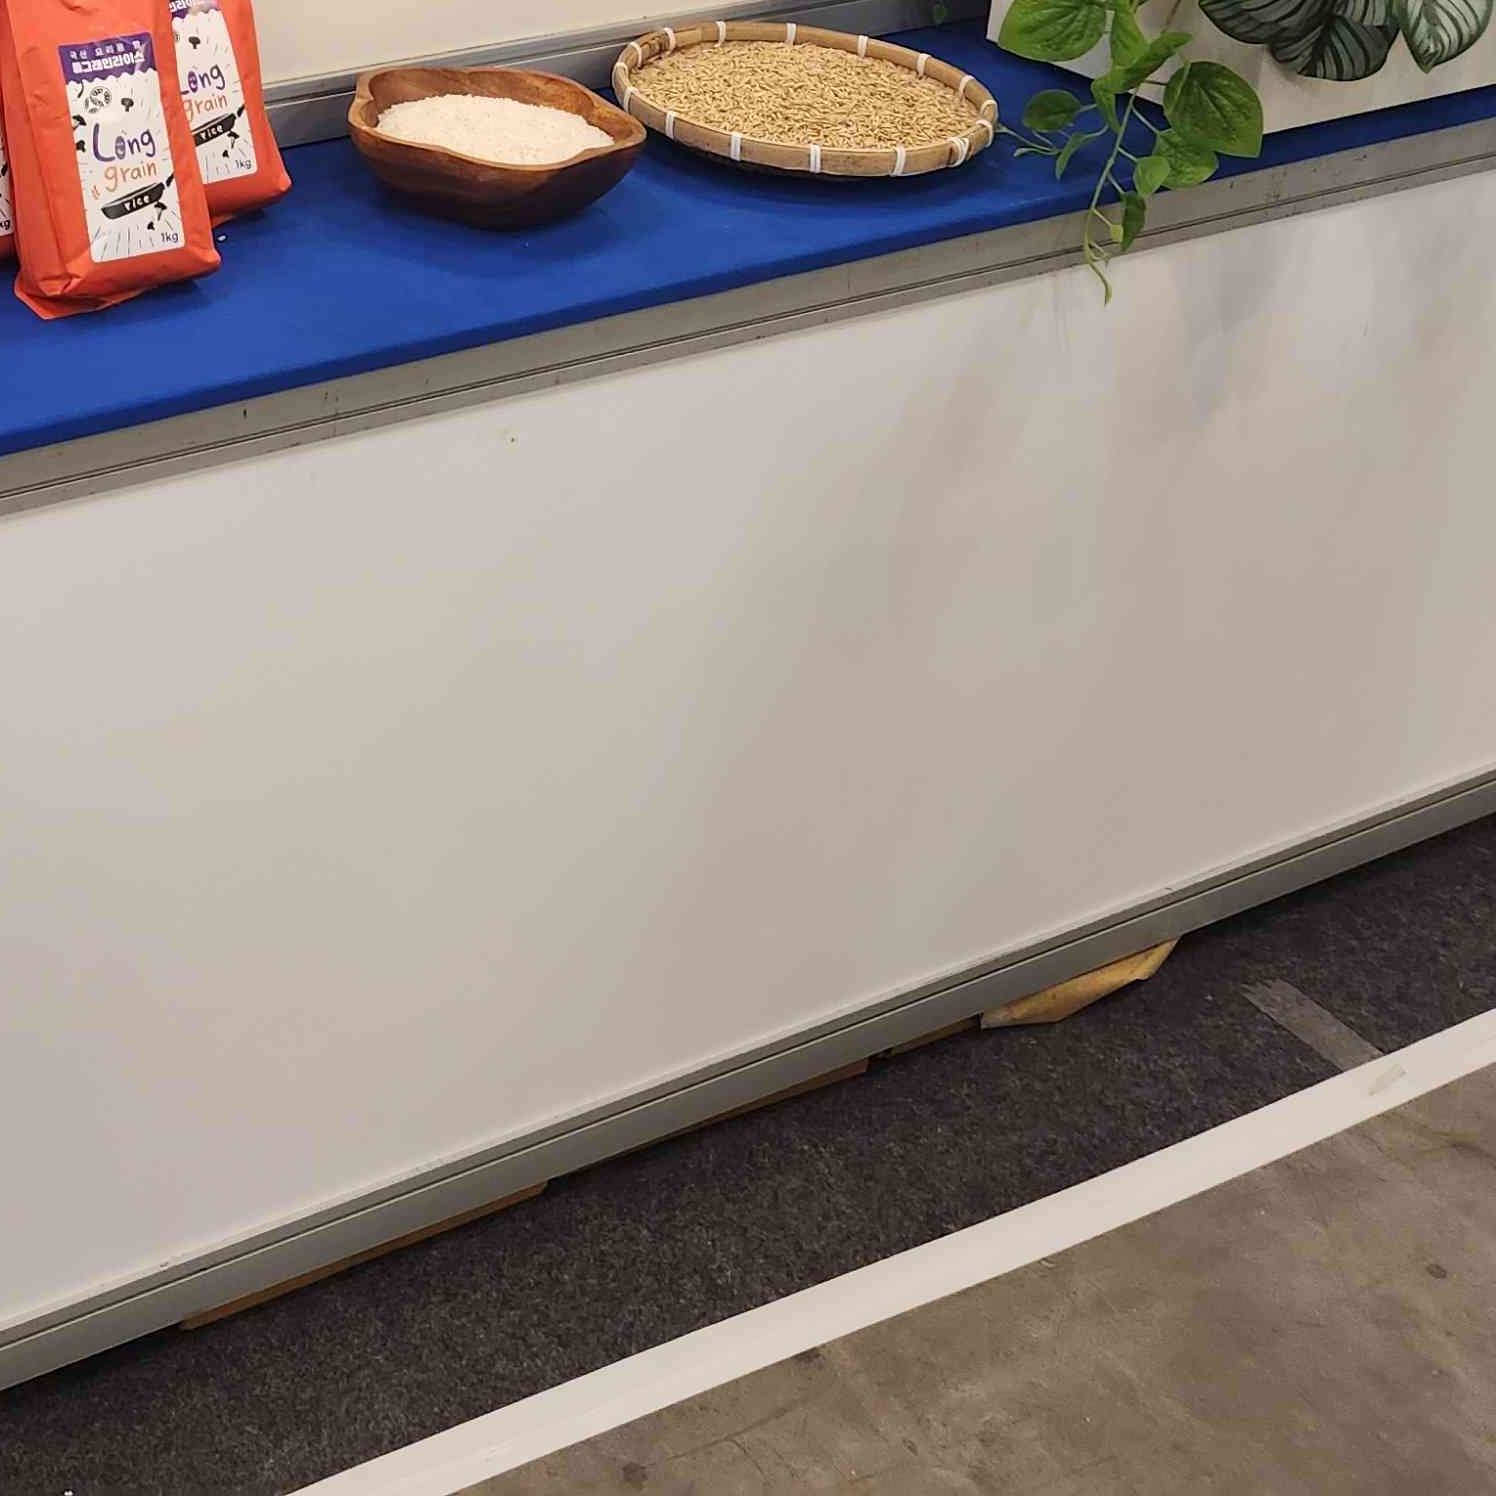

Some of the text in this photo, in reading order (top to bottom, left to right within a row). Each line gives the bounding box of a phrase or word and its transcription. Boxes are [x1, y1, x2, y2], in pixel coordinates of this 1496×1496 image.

[199, 123, 224, 140] rice
[92, 122, 156, 163] Long
[235, 159, 252, 170] 1kg
[104, 160, 158, 192] grain
[123, 192, 155, 212] rice
[160, 231, 180, 244] 1kg
